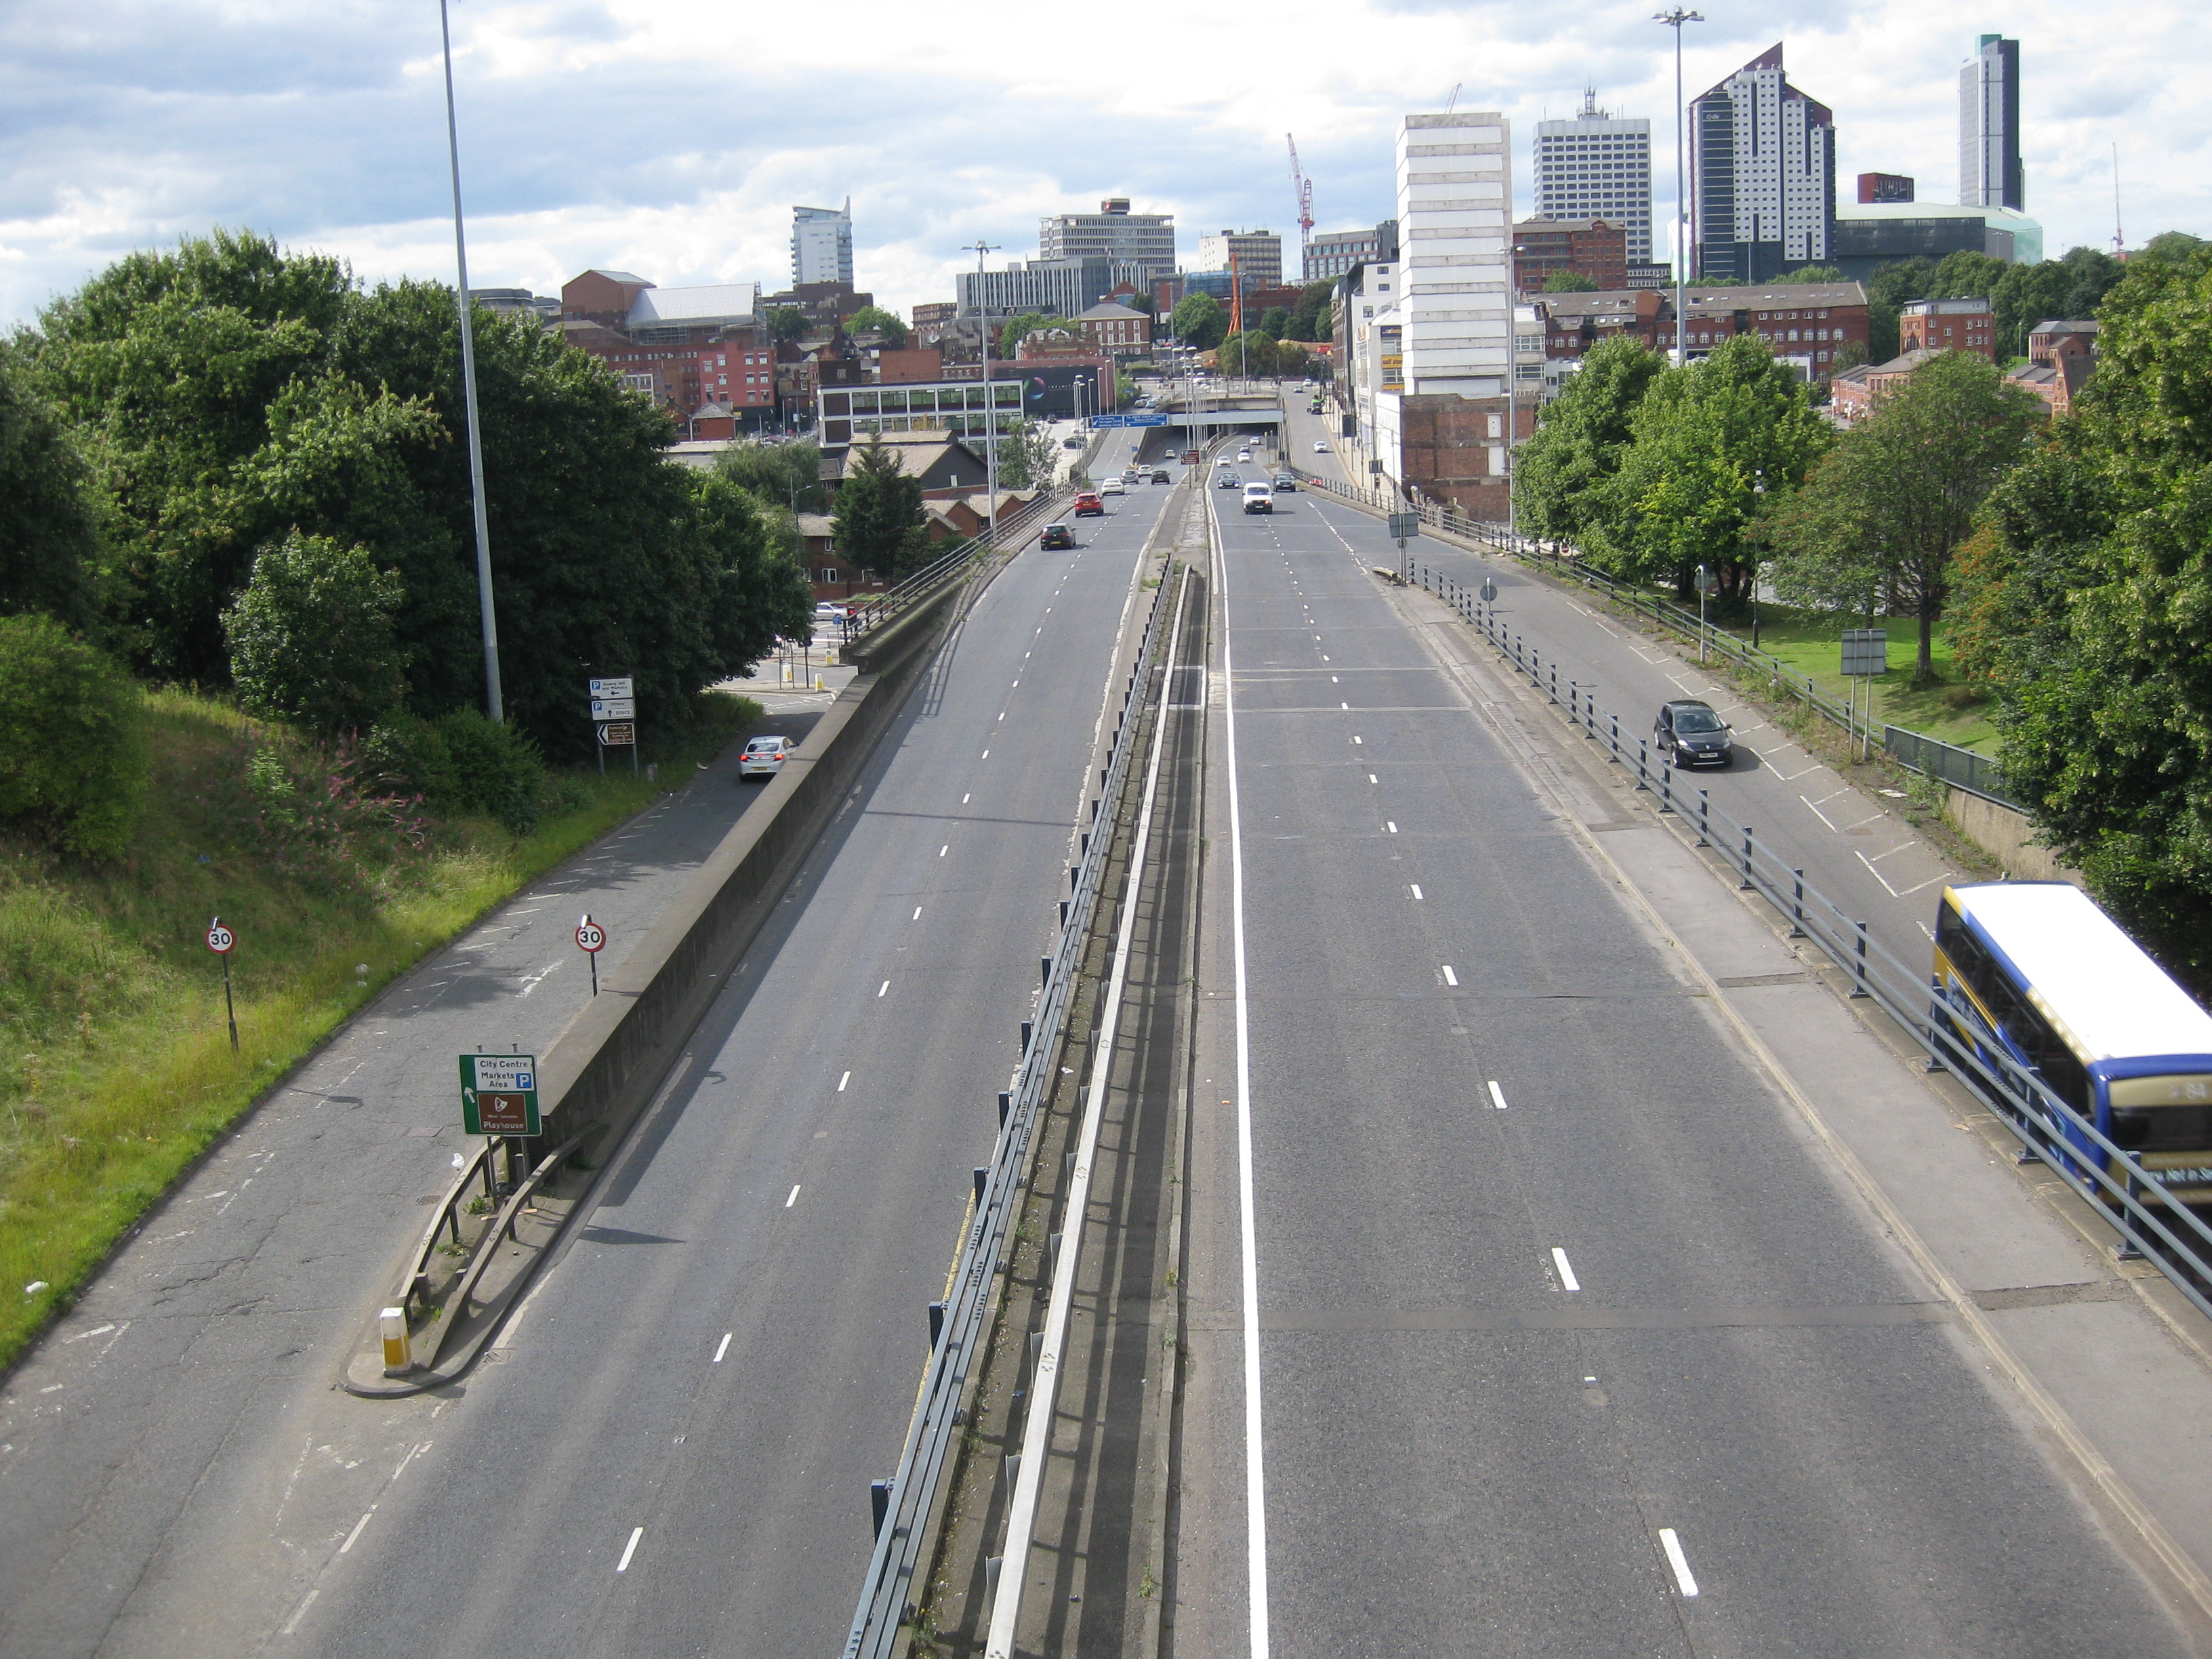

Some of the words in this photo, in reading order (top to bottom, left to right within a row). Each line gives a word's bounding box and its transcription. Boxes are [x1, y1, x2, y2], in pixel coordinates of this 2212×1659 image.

[211, 933, 230, 945] 30
[579, 930, 600, 943] 30
[480, 1060, 497, 1069] City
[499, 1060, 528, 1068] Centre
[489, 1080, 508, 1088] Area
[519, 1074, 530, 1088] P
[483, 1121, 525, 1130] Playhouse
